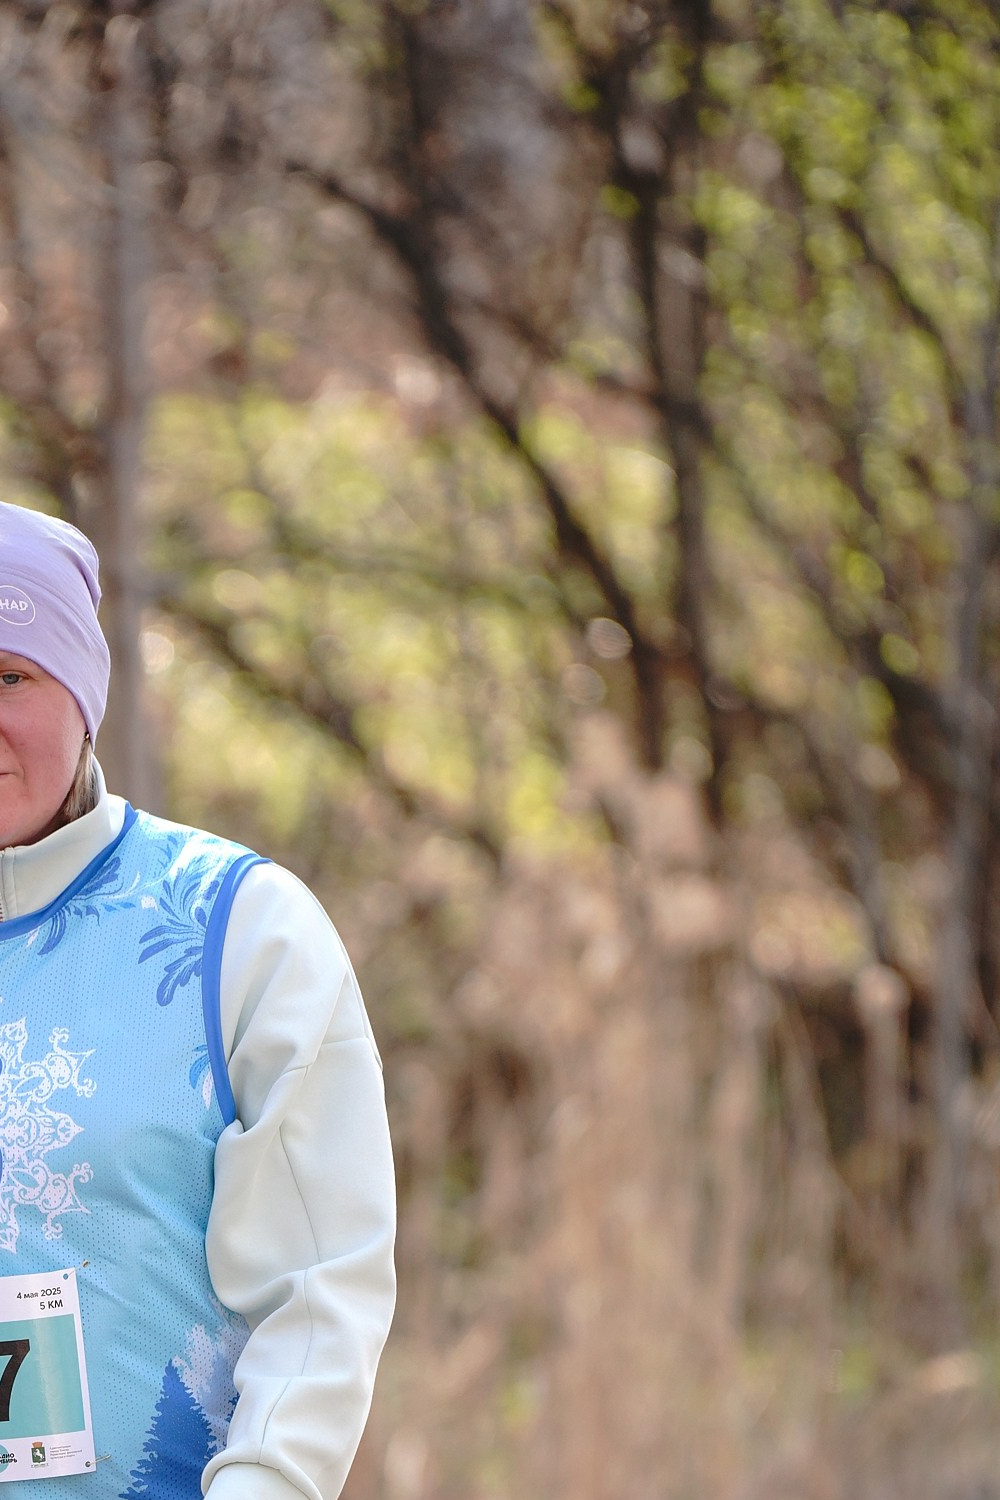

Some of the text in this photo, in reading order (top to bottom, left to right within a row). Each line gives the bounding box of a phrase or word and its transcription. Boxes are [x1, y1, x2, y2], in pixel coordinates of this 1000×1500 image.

[16, 1292, 22, 1300] 4
[40, 1286, 62, 1297] 2025
[39, 1299, 64, 1310] 5 КМ
